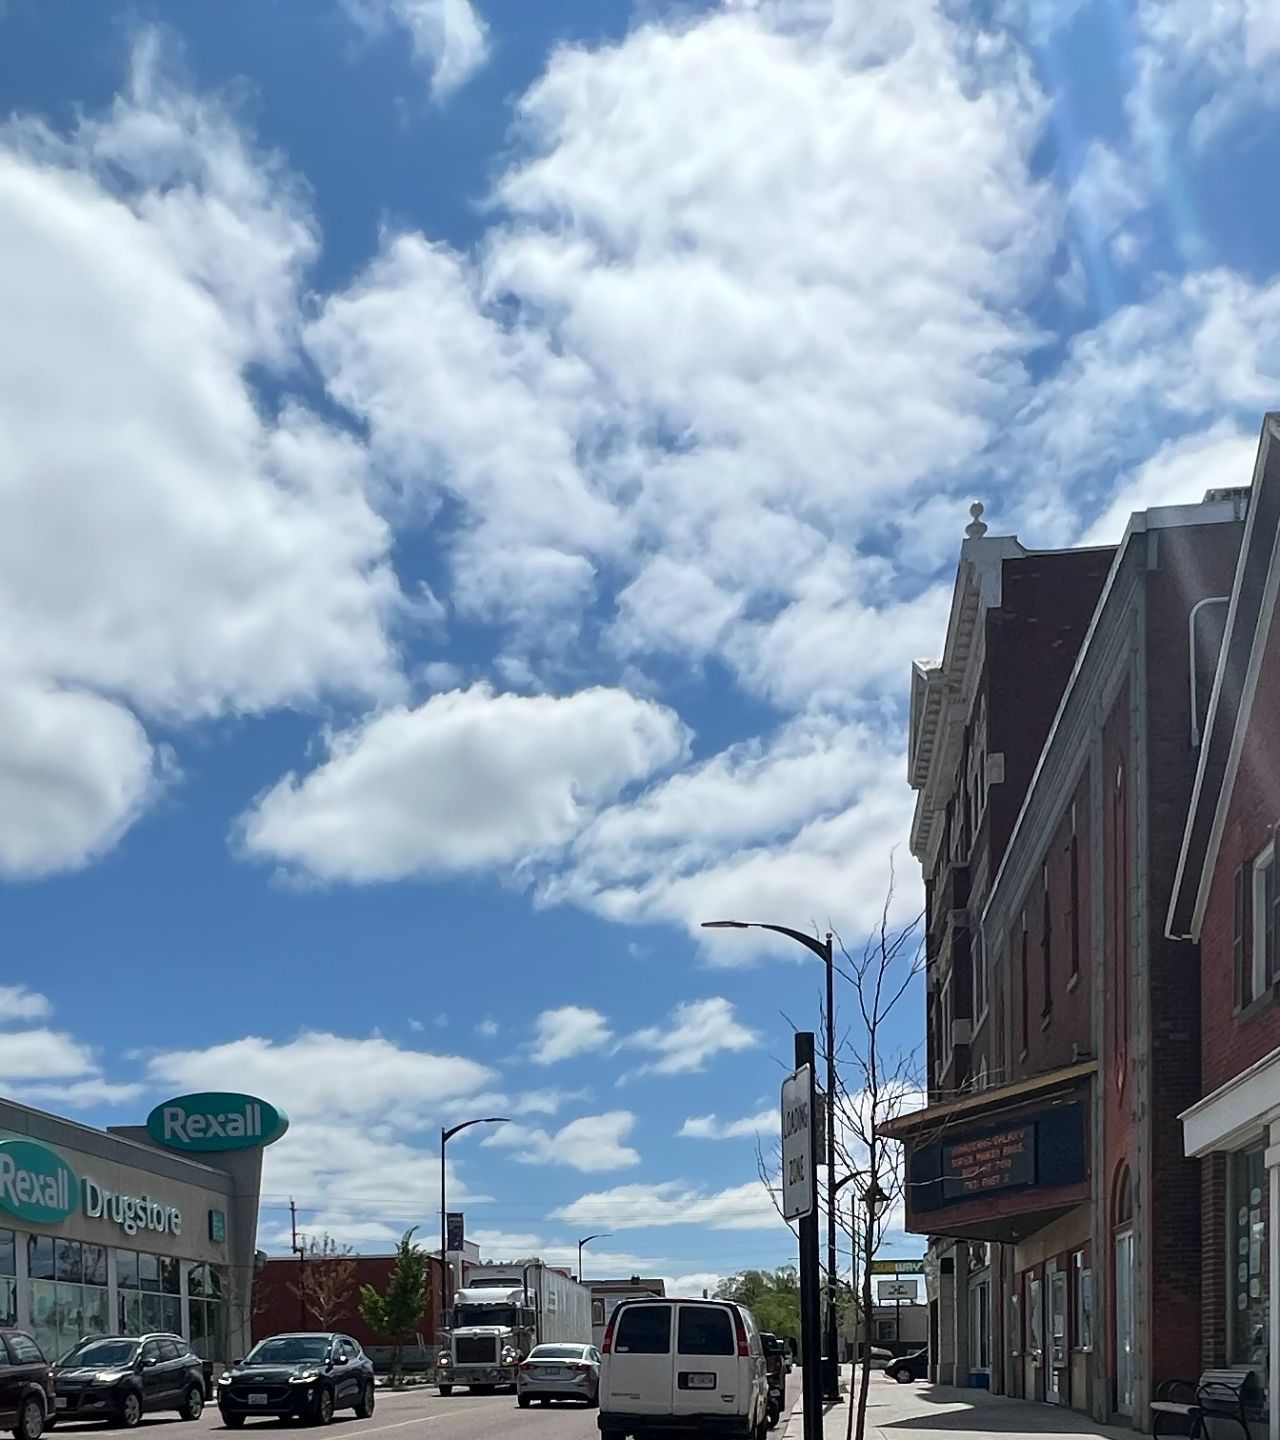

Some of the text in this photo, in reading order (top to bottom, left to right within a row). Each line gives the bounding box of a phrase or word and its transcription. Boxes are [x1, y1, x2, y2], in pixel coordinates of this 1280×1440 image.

[163, 1104, 261, 1142] Rexall
[81, 1177, 182, 1235] Drugstore
[873, 1262, 923, 1272] SUBWAY
